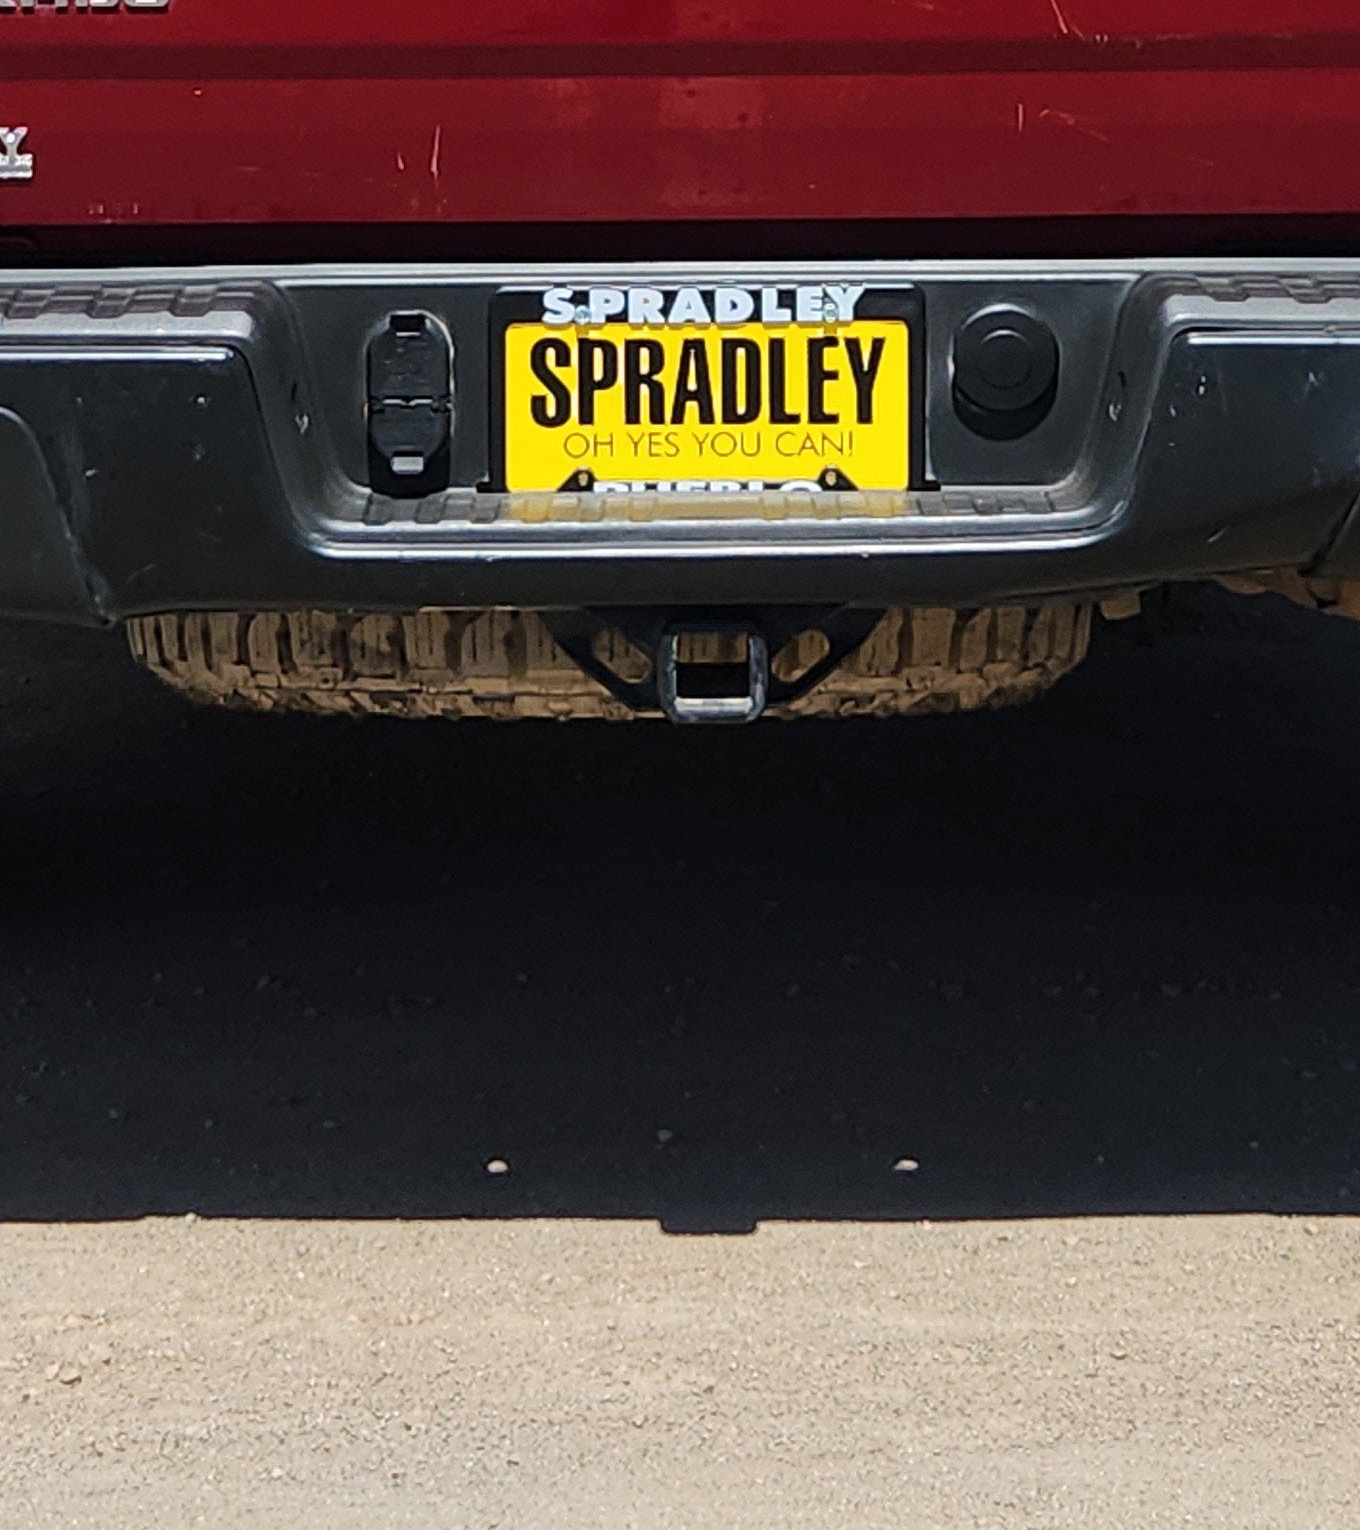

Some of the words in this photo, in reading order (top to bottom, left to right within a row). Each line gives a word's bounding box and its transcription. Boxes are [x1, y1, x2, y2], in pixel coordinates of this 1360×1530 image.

[541, 284, 866, 326] SPRADLEY
[529, 336, 887, 428] SPRADLEY
[563, 432, 615, 459] OH
[626, 432, 681, 459] YES
[692, 432, 762, 458] YOU
[774, 430, 855, 458] CAN!
